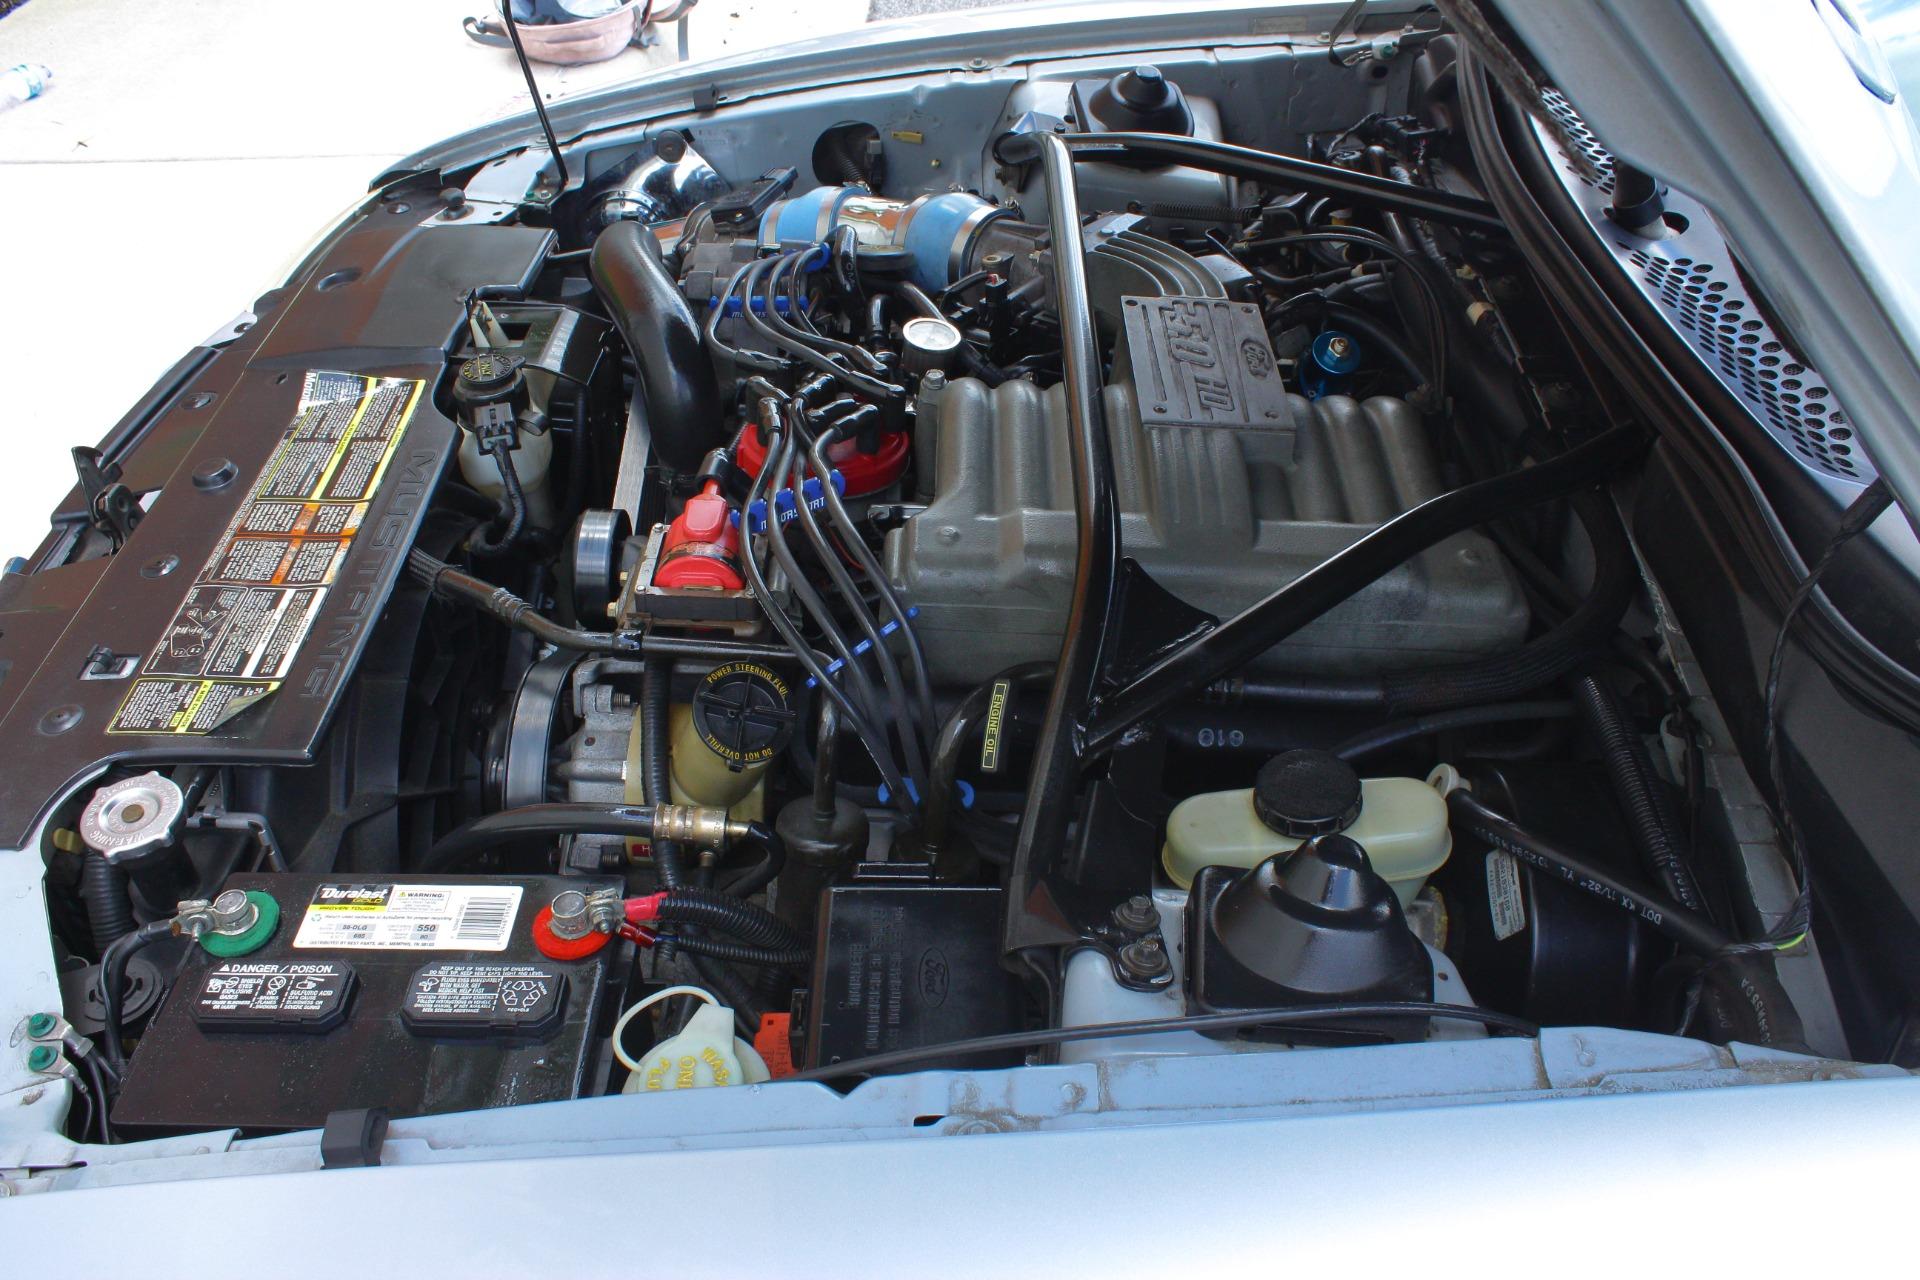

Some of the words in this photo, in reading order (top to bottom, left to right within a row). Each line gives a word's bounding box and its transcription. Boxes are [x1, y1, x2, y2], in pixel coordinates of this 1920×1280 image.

[299, 451, 436, 697] MUSTANG
[706, 666, 732, 684] POWER
[735, 663, 773, 680] STEERING
[987, 694, 1003, 736] ENGINE
[706, 733, 740, 760] OVERFILL
[761, 747, 773, 757] DO
[985, 737, 996, 758] OIL
[744, 751, 761, 761] NOT
[90, 830, 146, 846] WARNING
[320, 887, 388, 899] Duralast
[1639, 908, 1663, 926] DOT
[417, 924, 436, 932] 550
